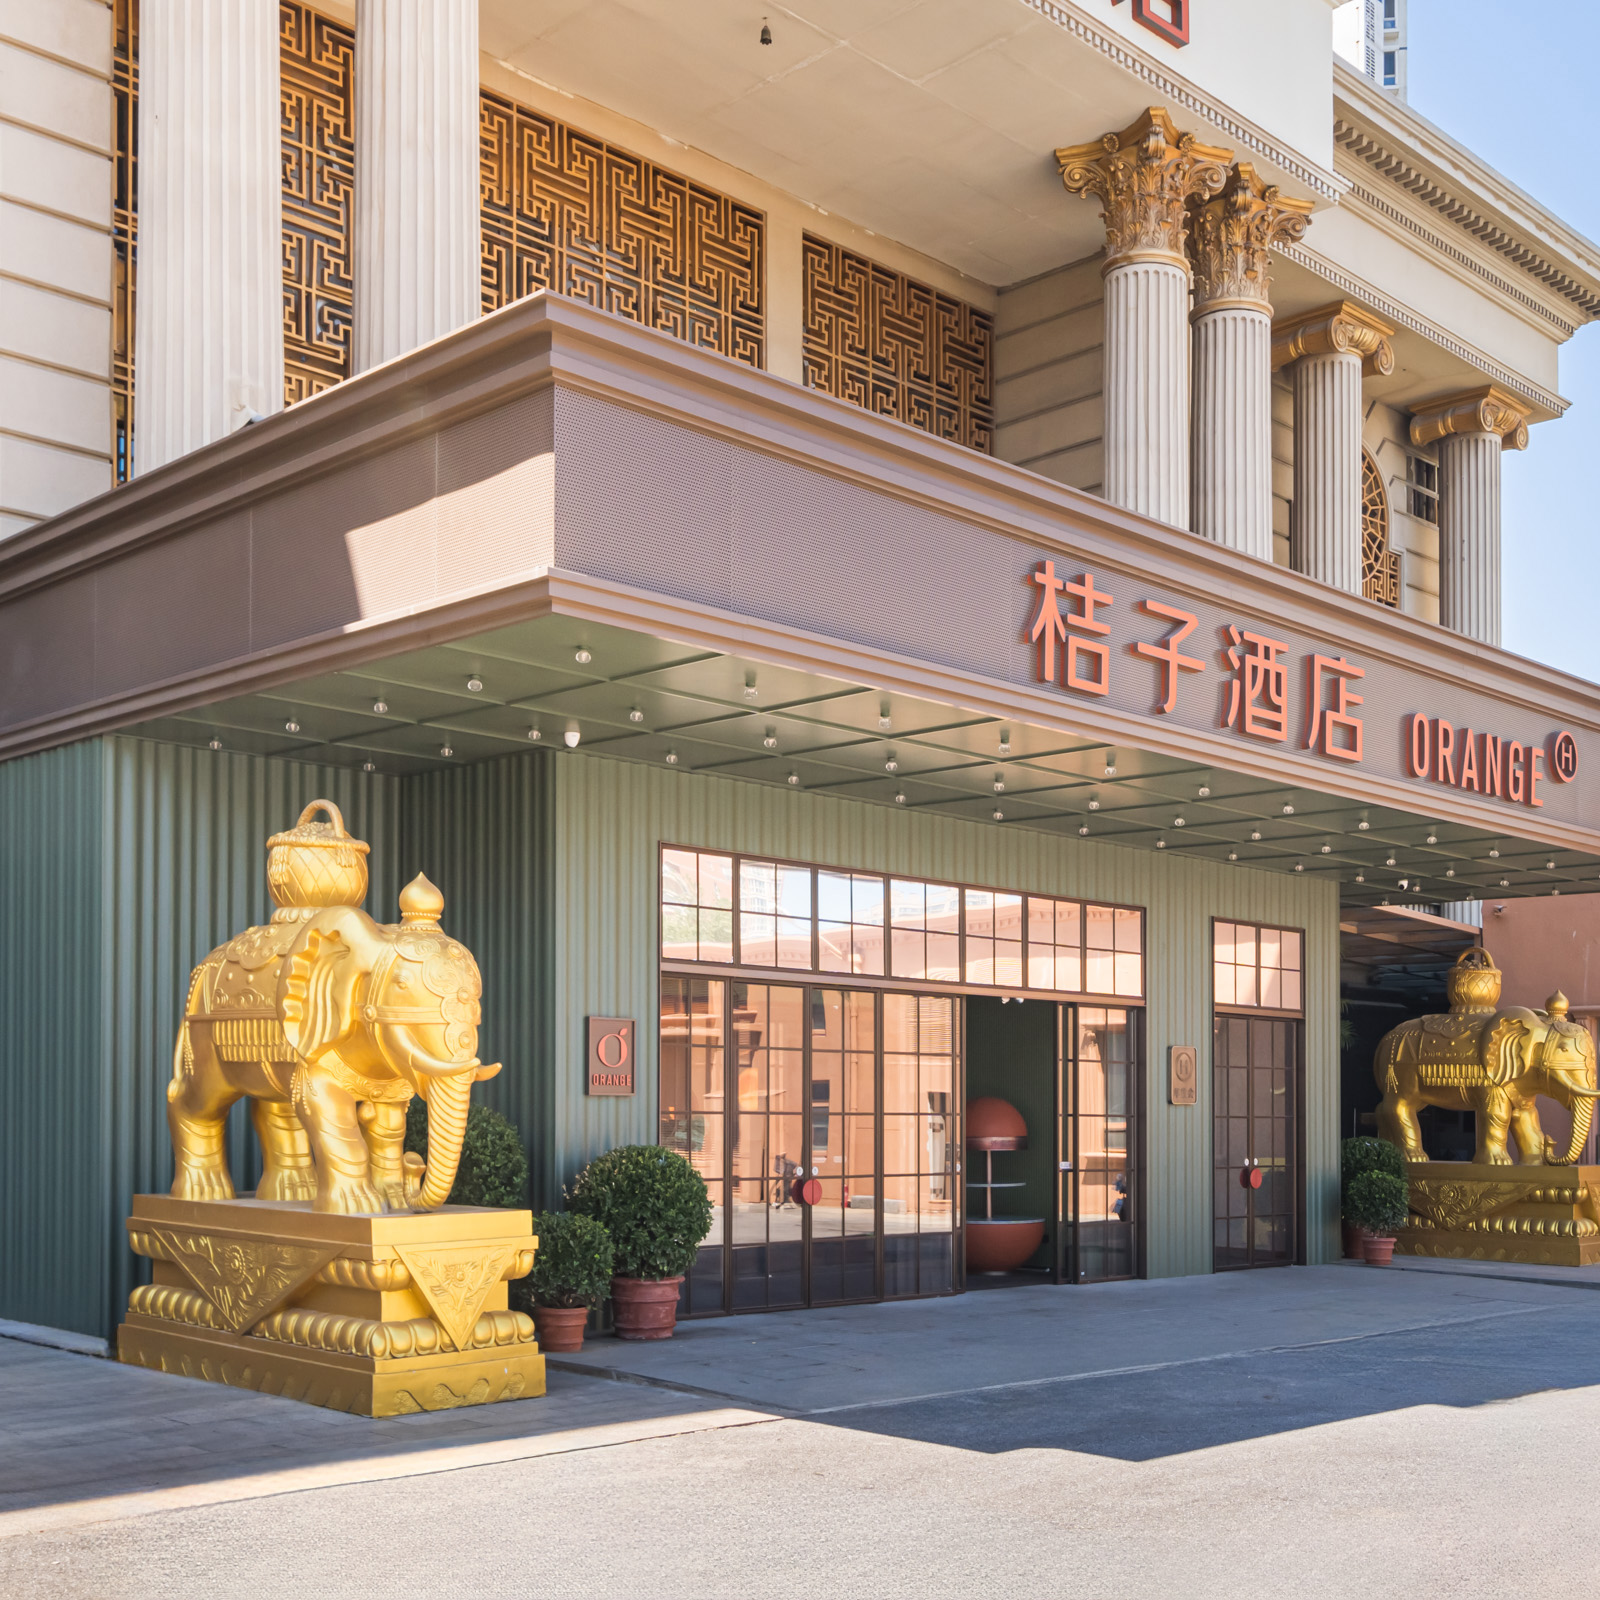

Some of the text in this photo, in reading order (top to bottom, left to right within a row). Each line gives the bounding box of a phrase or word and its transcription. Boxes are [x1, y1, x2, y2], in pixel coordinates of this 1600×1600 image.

[1026, 560, 1366, 763] 桔子酒店
[1406, 712, 1545, 807] ORANGE
[592, 1073, 632, 1086] ORANGE
